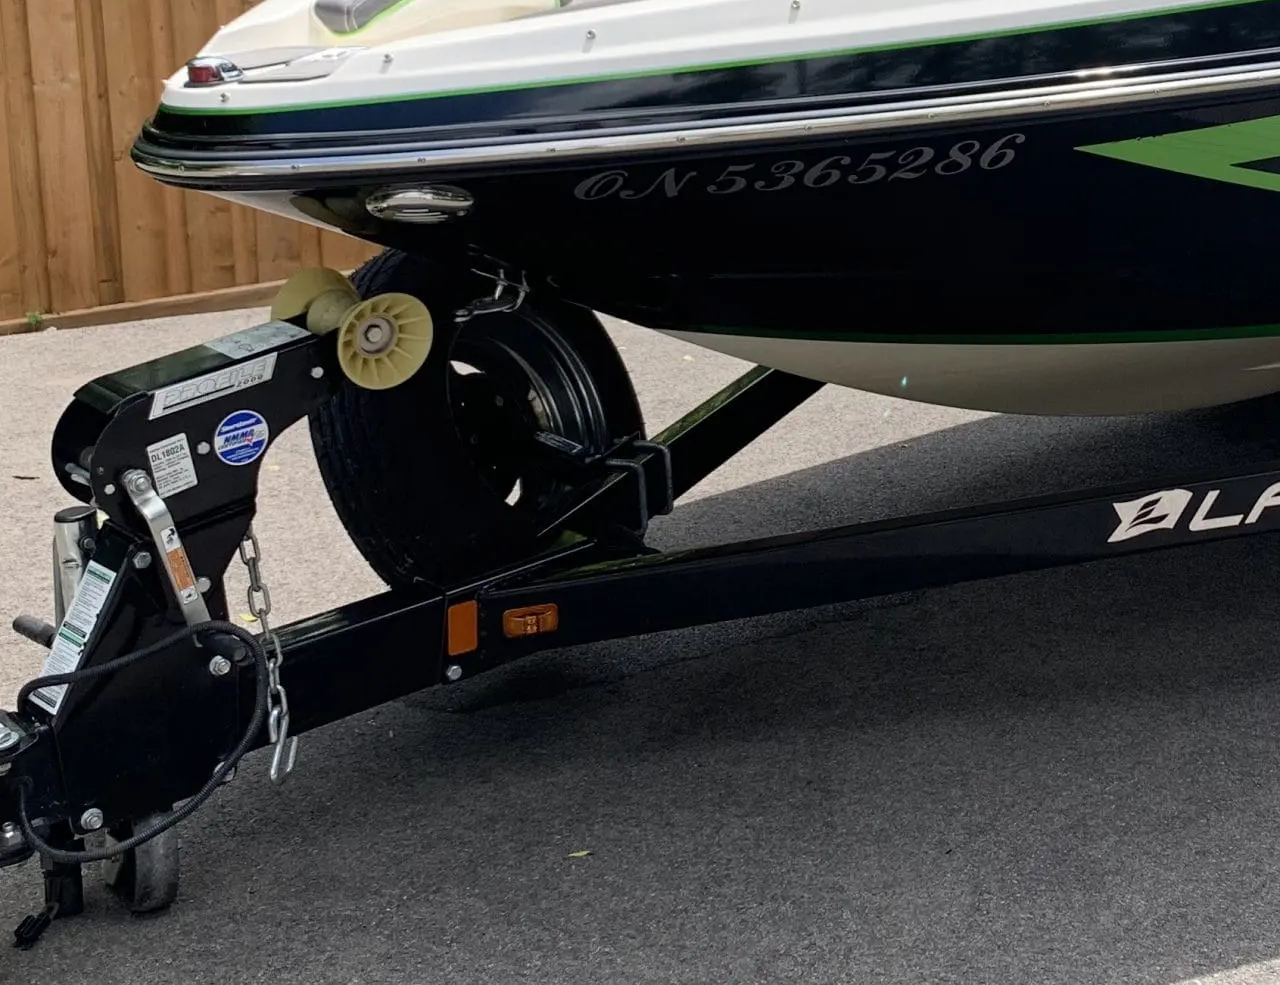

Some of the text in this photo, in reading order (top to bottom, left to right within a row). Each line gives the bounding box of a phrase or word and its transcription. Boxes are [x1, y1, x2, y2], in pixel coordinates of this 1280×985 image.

[574, 132, 1026, 201] ON 5365286
[163, 359, 268, 405] PROFILE
